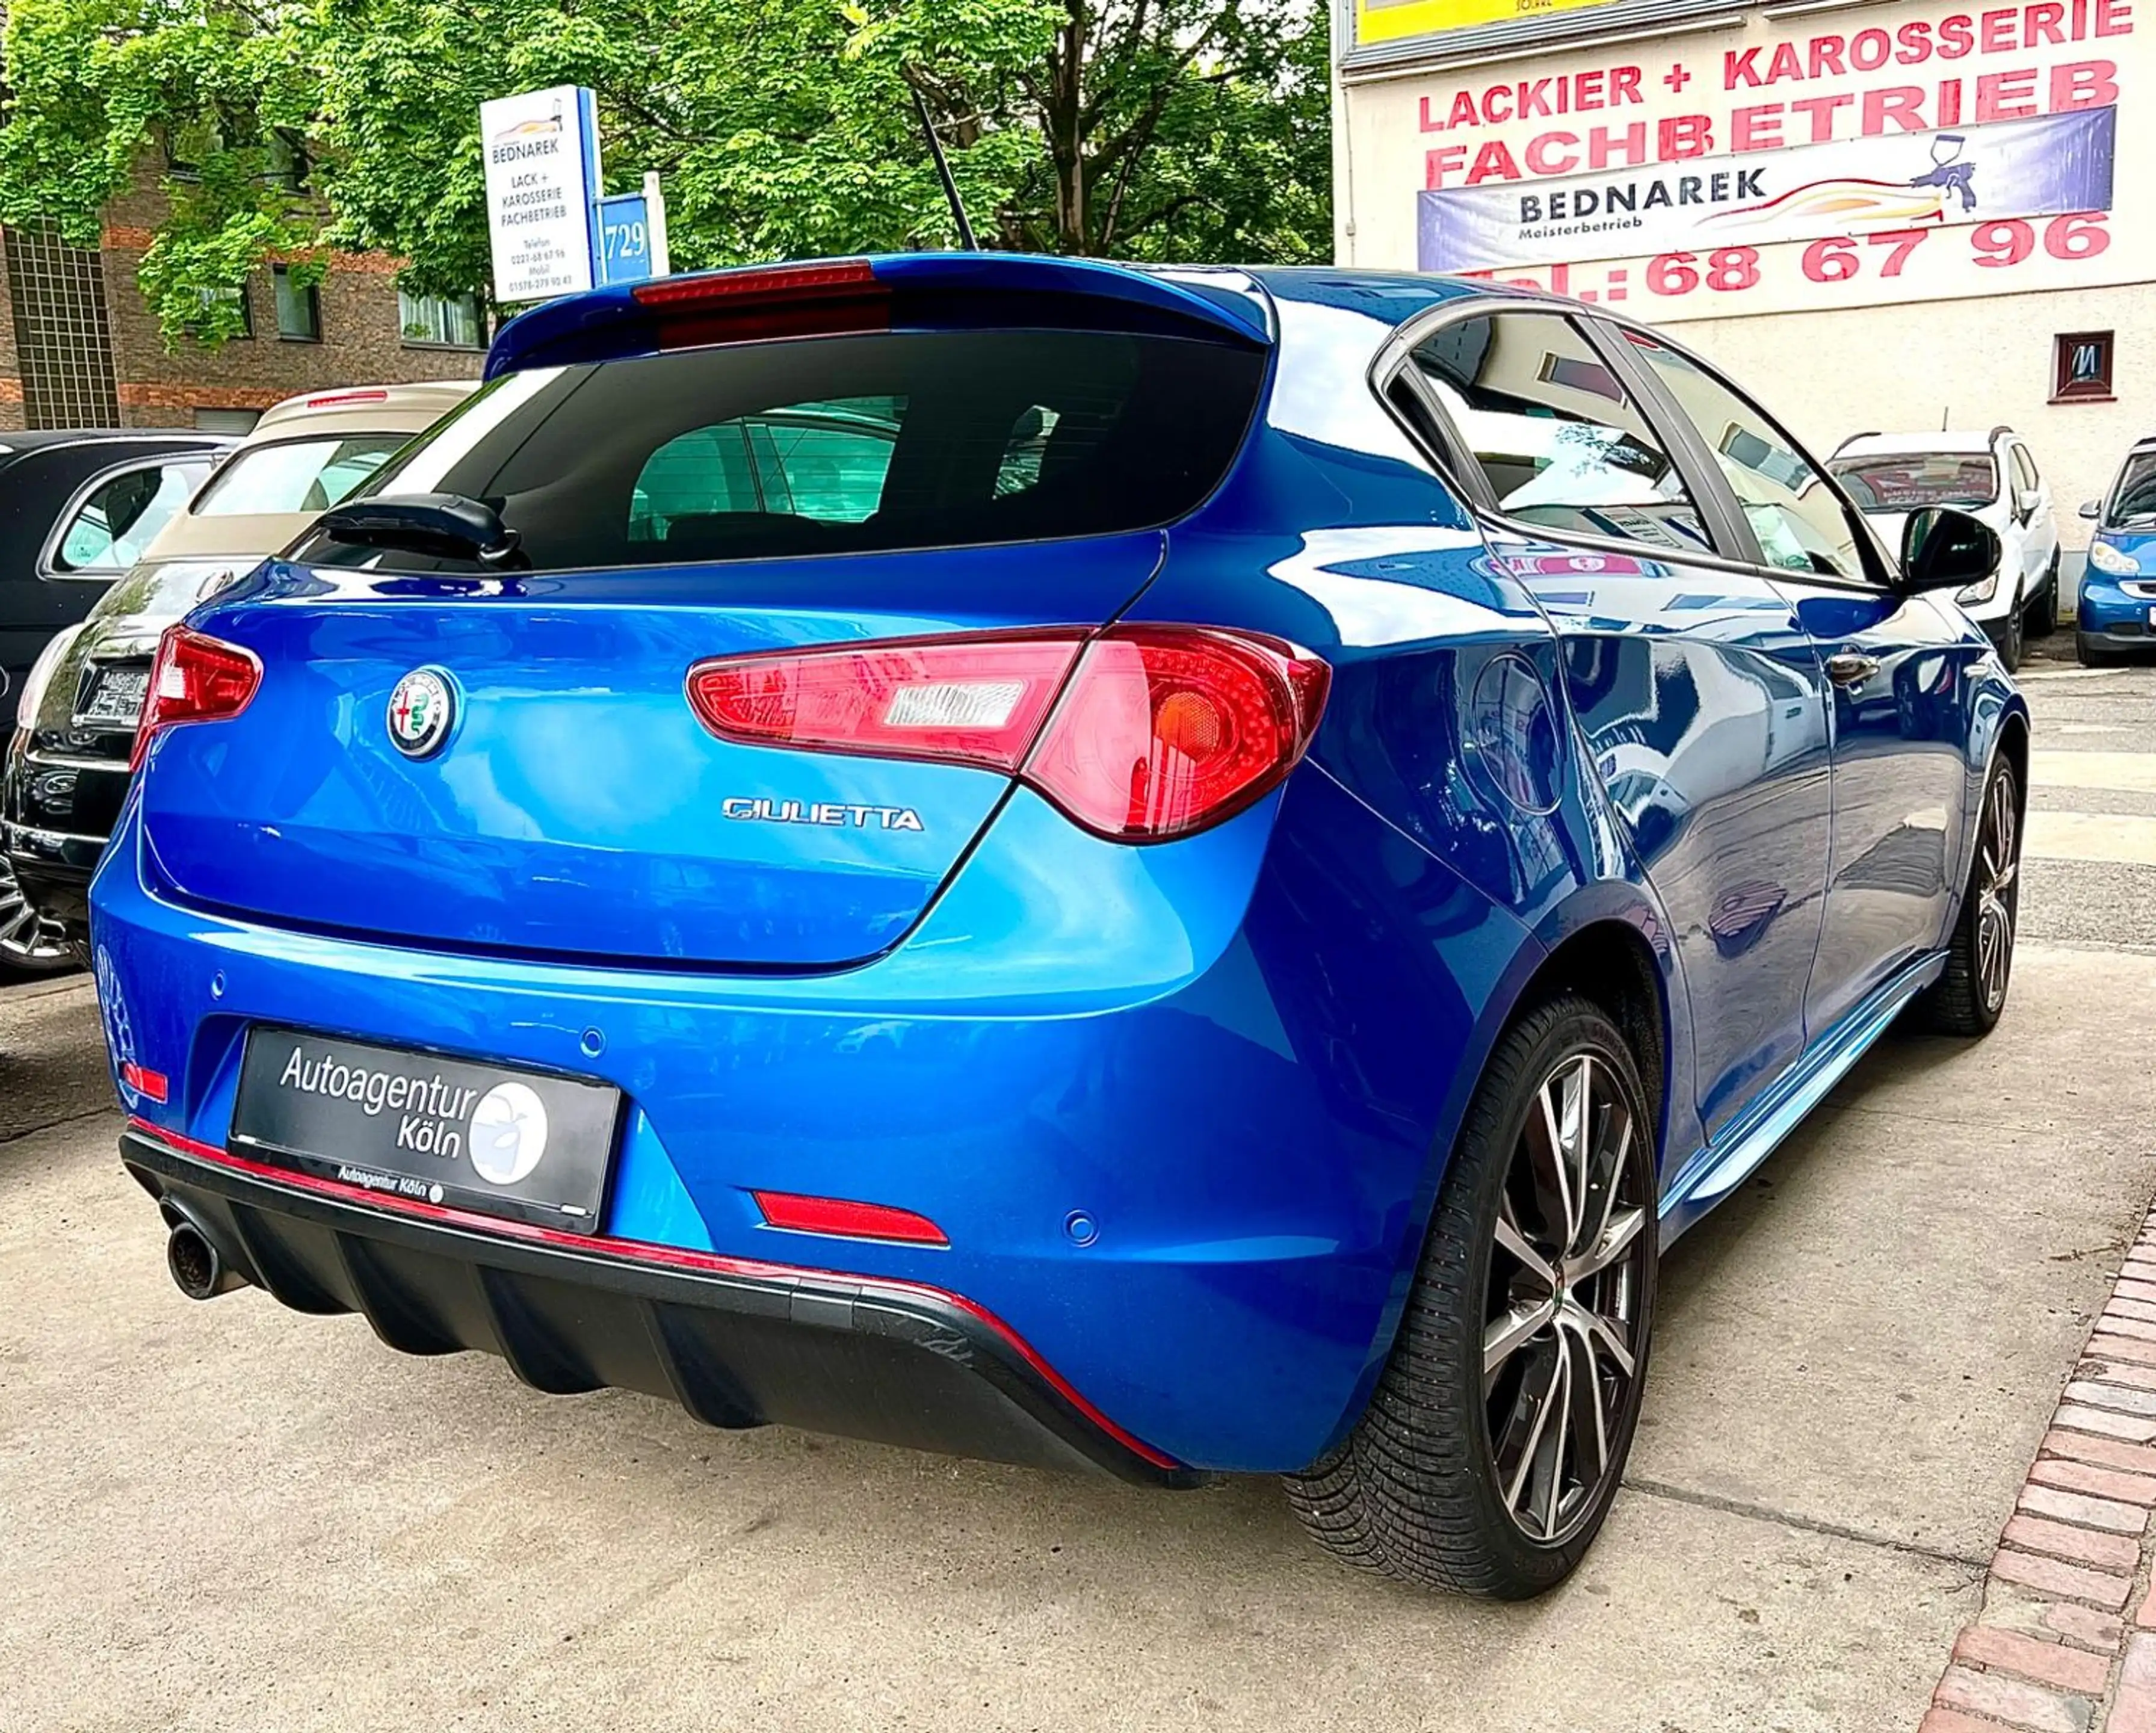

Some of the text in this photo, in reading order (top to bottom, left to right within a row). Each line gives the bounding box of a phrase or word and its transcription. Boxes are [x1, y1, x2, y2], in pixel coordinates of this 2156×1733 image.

[1419, 0, 2134, 133] LACKIER + KAROSSERIE
[1425, 60, 2119, 191] FACHBETRIEB
[493, 138, 559, 164] BEDNAREK
[502, 187, 562, 208] KAROSSERIE
[511, 173, 538, 188] LACK
[1521, 167, 1767, 223] BEDNAREK
[501, 205, 567, 227] FACHBETRIEB
[1519, 217, 1643, 239] Meisterbetrieb
[605, 221, 644, 259] 729
[1646, 246, 1761, 295] 68
[1802, 228, 1930, 282] 67
[1971, 212, 2111, 267] 96
[722, 797, 925, 831] GIULIETTA
[279, 1046, 478, 1120] Autoagentur
[397, 1114, 462, 1159] Köln
[338, 1164, 427, 1196] Autoagentur Köln
